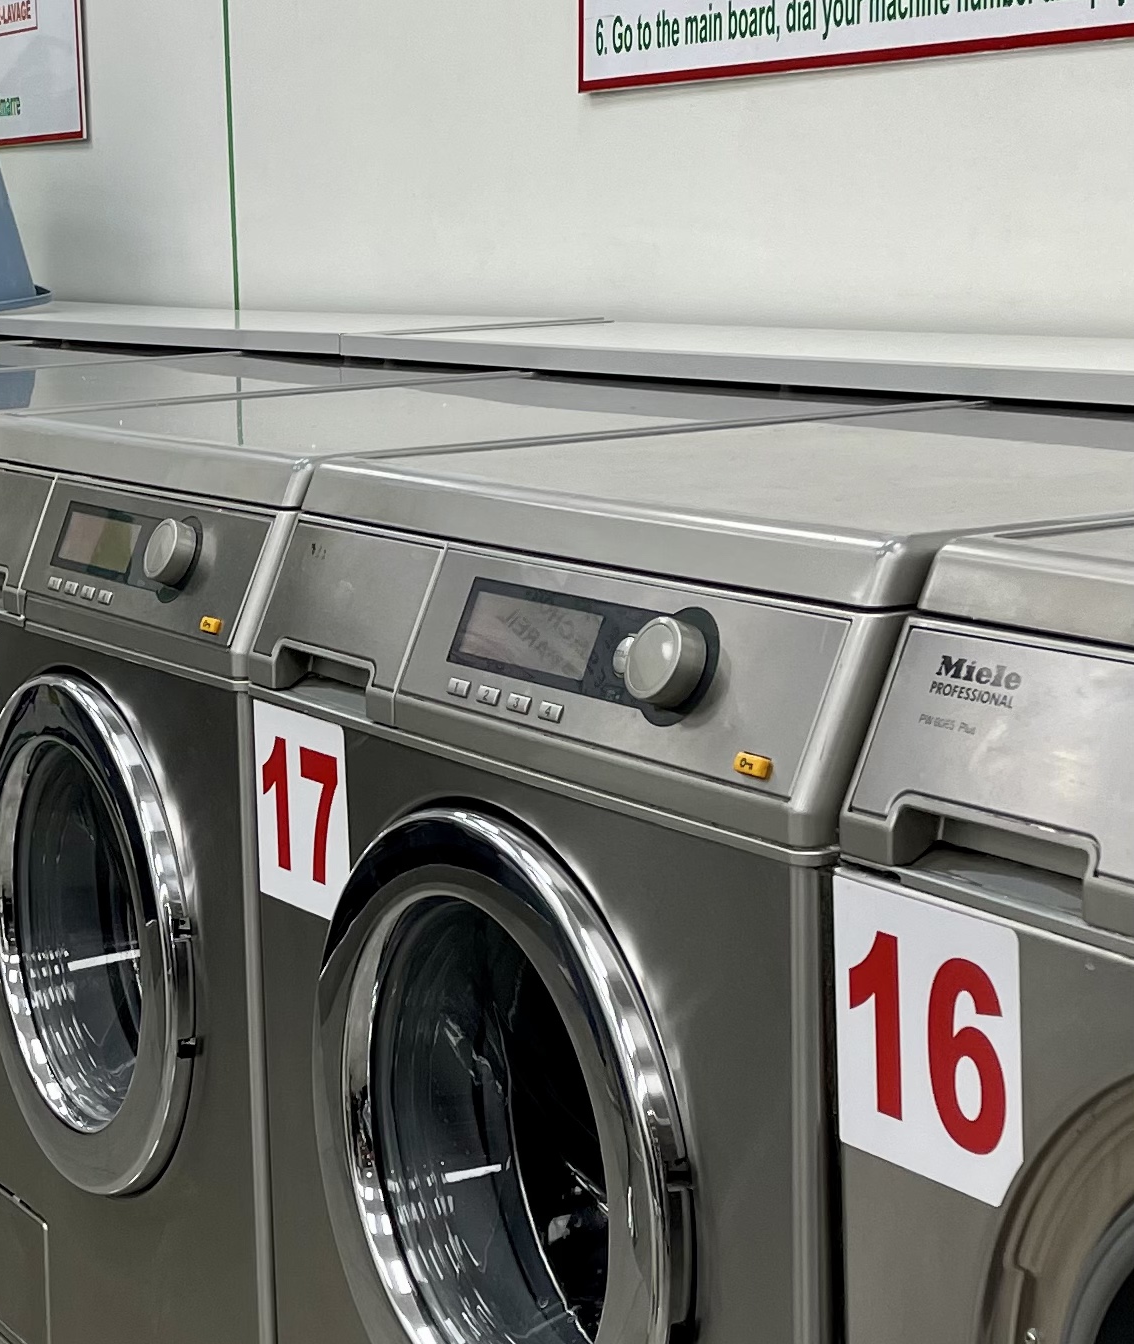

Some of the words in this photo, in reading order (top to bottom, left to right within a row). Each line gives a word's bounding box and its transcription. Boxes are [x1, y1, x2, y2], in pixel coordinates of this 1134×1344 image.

[596, 18, 607, 56] 6.
[613, 15, 632, 54] Go
[638, 16, 651, 49] to
[657, 10, 679, 47] the
[685, 3, 722, 44] main
[936, 655, 1021, 690] Miele
[454, 682, 459, 692] 1
[483, 689, 489, 701] 2
[929, 681, 1013, 709] PROFESSIONAL
[513, 697, 519, 708] 3
[545, 705, 551, 716] 4
[261, 735, 339, 885] 17
[848, 930, 1008, 1155] 16
